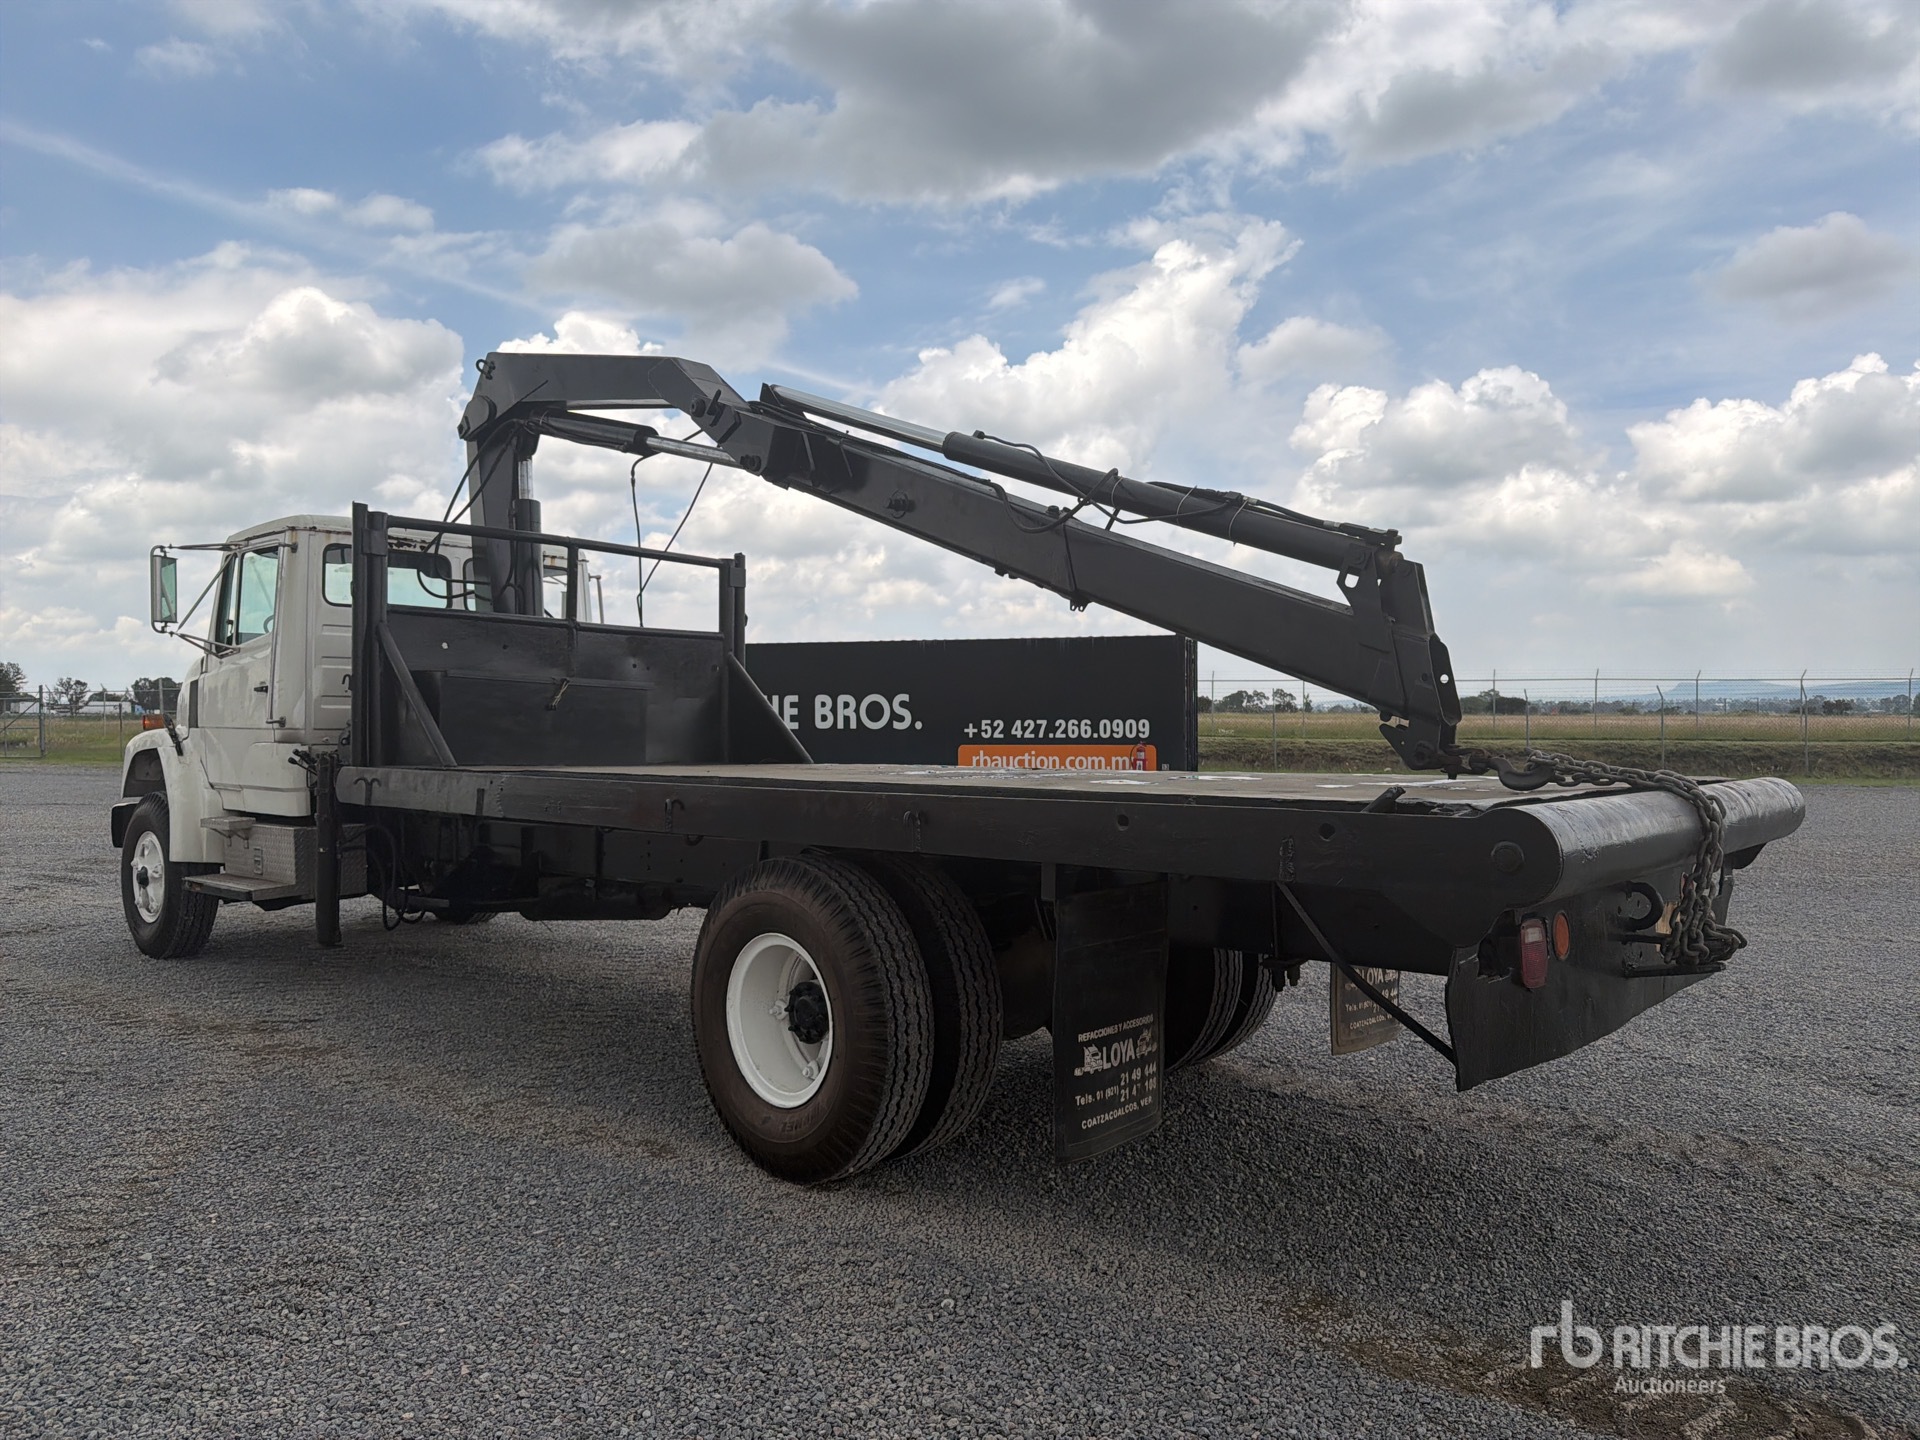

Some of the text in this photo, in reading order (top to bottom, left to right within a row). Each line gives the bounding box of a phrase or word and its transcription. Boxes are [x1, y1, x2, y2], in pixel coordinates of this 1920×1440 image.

[814, 693, 923, 730] BROS.
[964, 719, 1150, 739] +52 427.266.0909
[972, 750, 1134, 769] rbauction.com.m
[1078, 1025, 1118, 1042] REFACCIONES
[1118, 1022, 1123, 1032] Y
[1102, 1038, 1135, 1069] LOYA
[1120, 1071, 1129, 1086] 21
[1131, 1067, 1141, 1081] 49
[1075, 1093, 1095, 1106] Tels.
[1120, 1086, 1129, 1102] 21
[1081, 1101, 1139, 1129] COATZACOALCOS,
